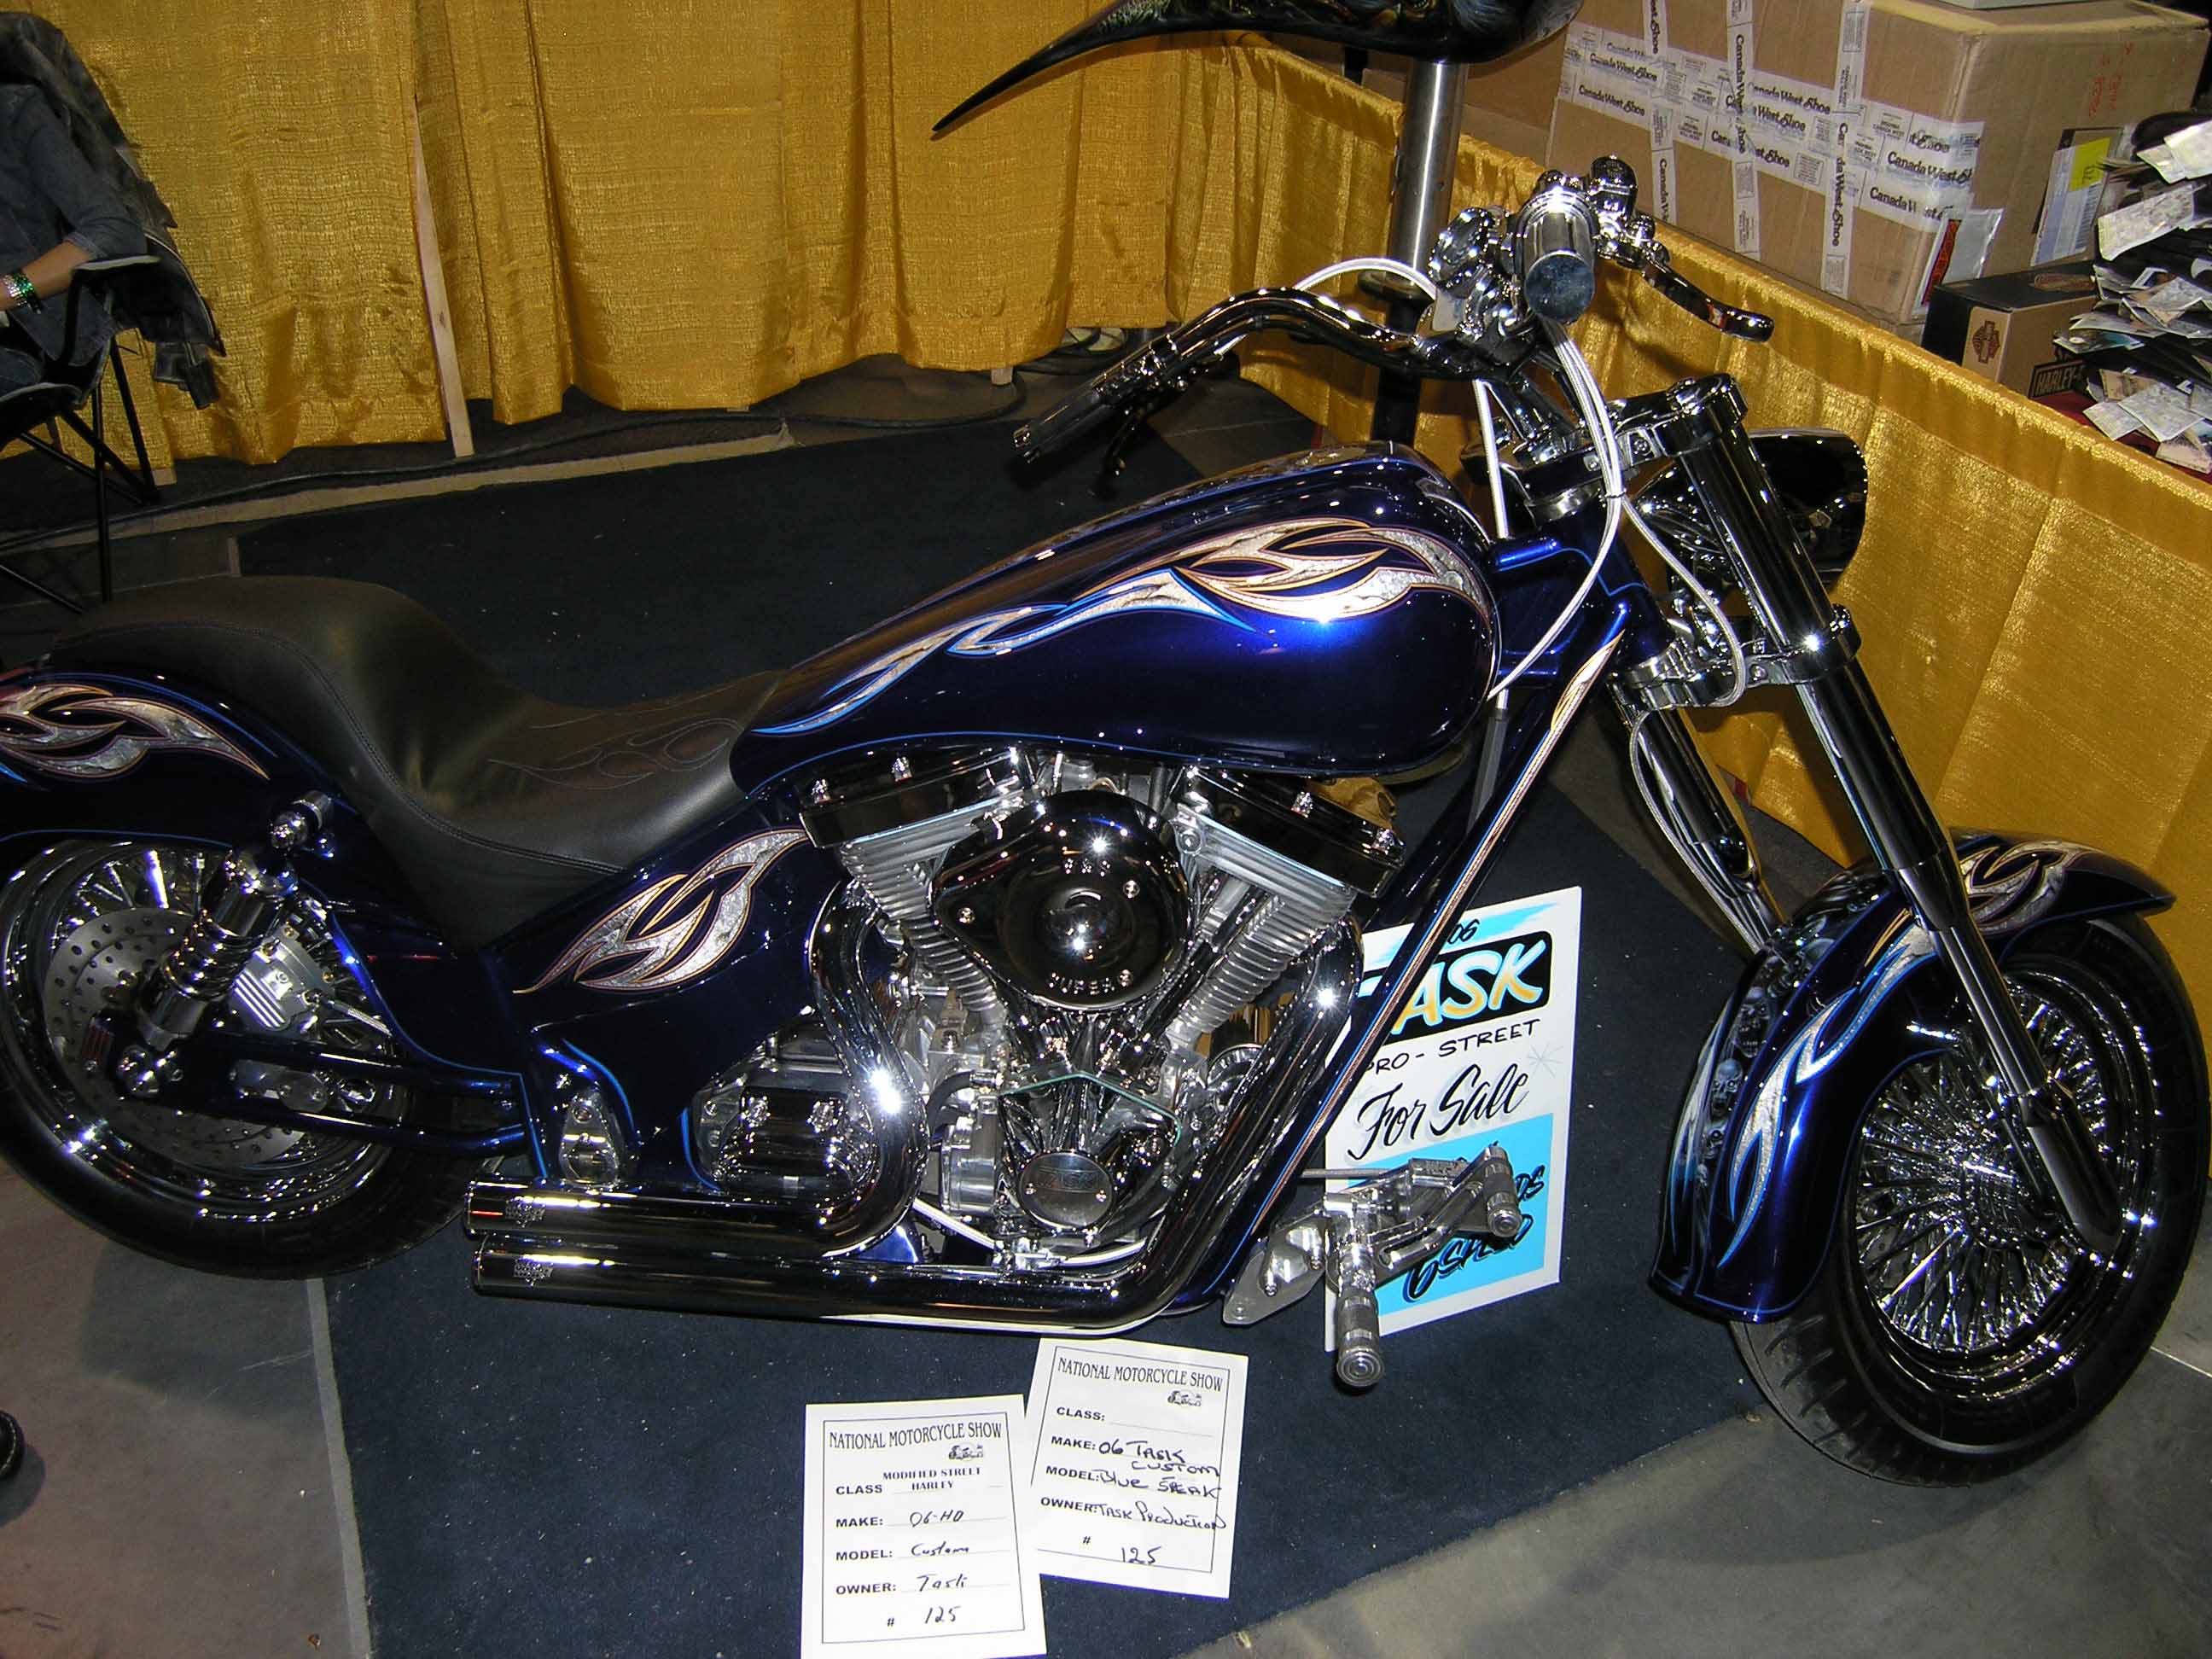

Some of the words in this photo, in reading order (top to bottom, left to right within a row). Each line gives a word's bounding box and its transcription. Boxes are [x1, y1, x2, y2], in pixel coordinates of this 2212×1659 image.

[1650, 20, 1660, 55] Shoe
[1590, 53, 1615, 69] Canada
[1615, 60, 1635, 74] West
[1634, 67, 1657, 82] Shoe
[1735, 34, 1745, 84] Canada
[1579, 84, 1604, 102] Canada
[1604, 92, 1623, 108] West
[1621, 99, 1645, 117] Shoe
[1780, 90, 1803, 106] West
[1803, 97, 1831, 114] Shoe
[1758, 104, 1779, 124] West
[1779, 113, 1806, 131] Shoe
[1764, 149, 1790, 167] Shoe
[1888, 151, 1925, 175] Canada
[1927, 164, 1959, 183] West
[1659, 158, 1669, 204] Canada
[1835, 173, 1844, 207] West
[1870, 187, 1907, 212] Canada
[1832, 207, 1843, 247] Shoe
[1358, 939, 1546, 1035] ASK
[1439, 1018, 1540, 1057] STREET
[1348, 1082, 1428, 1161] For
[1429, 1062, 1529, 1137] Sale
[1057, 1357, 1110, 1380] NATIONAL
[1114, 1365, 1187, 1386] MOTORCYCLE
[1190, 1371, 1223, 1392] SHOW
[1056, 1406, 1105, 1422] CLASS:
[829, 1431, 886, 1449] NATIONAL
[889, 1423, 965, 1447] MOTORCYCLE
[968, 1421, 1002, 1439] SHOW
[1051, 1435, 1096, 1450] MAKE:
[1098, 1439, 1124, 1455] 06
[882, 1469, 937, 1481] MODIFIED
[940, 1467, 981, 1477] STREET
[1045, 1465, 1099, 1481] MODEL:
[835, 1484, 882, 1495] CLASS
[911, 1481, 954, 1491] HARLEY
[1040, 1497, 1097, 1513] OWNER:
[835, 1516, 883, 1528] MAKE:
[1082, 1536, 1091, 1545] #
[835, 1550, 893, 1561] MODEL:
[1121, 1546, 1161, 1564] 125
[835, 1582, 896, 1595] OWNER:
[887, 1617, 894, 1627] #
[924, 1606, 961, 1624] 125
